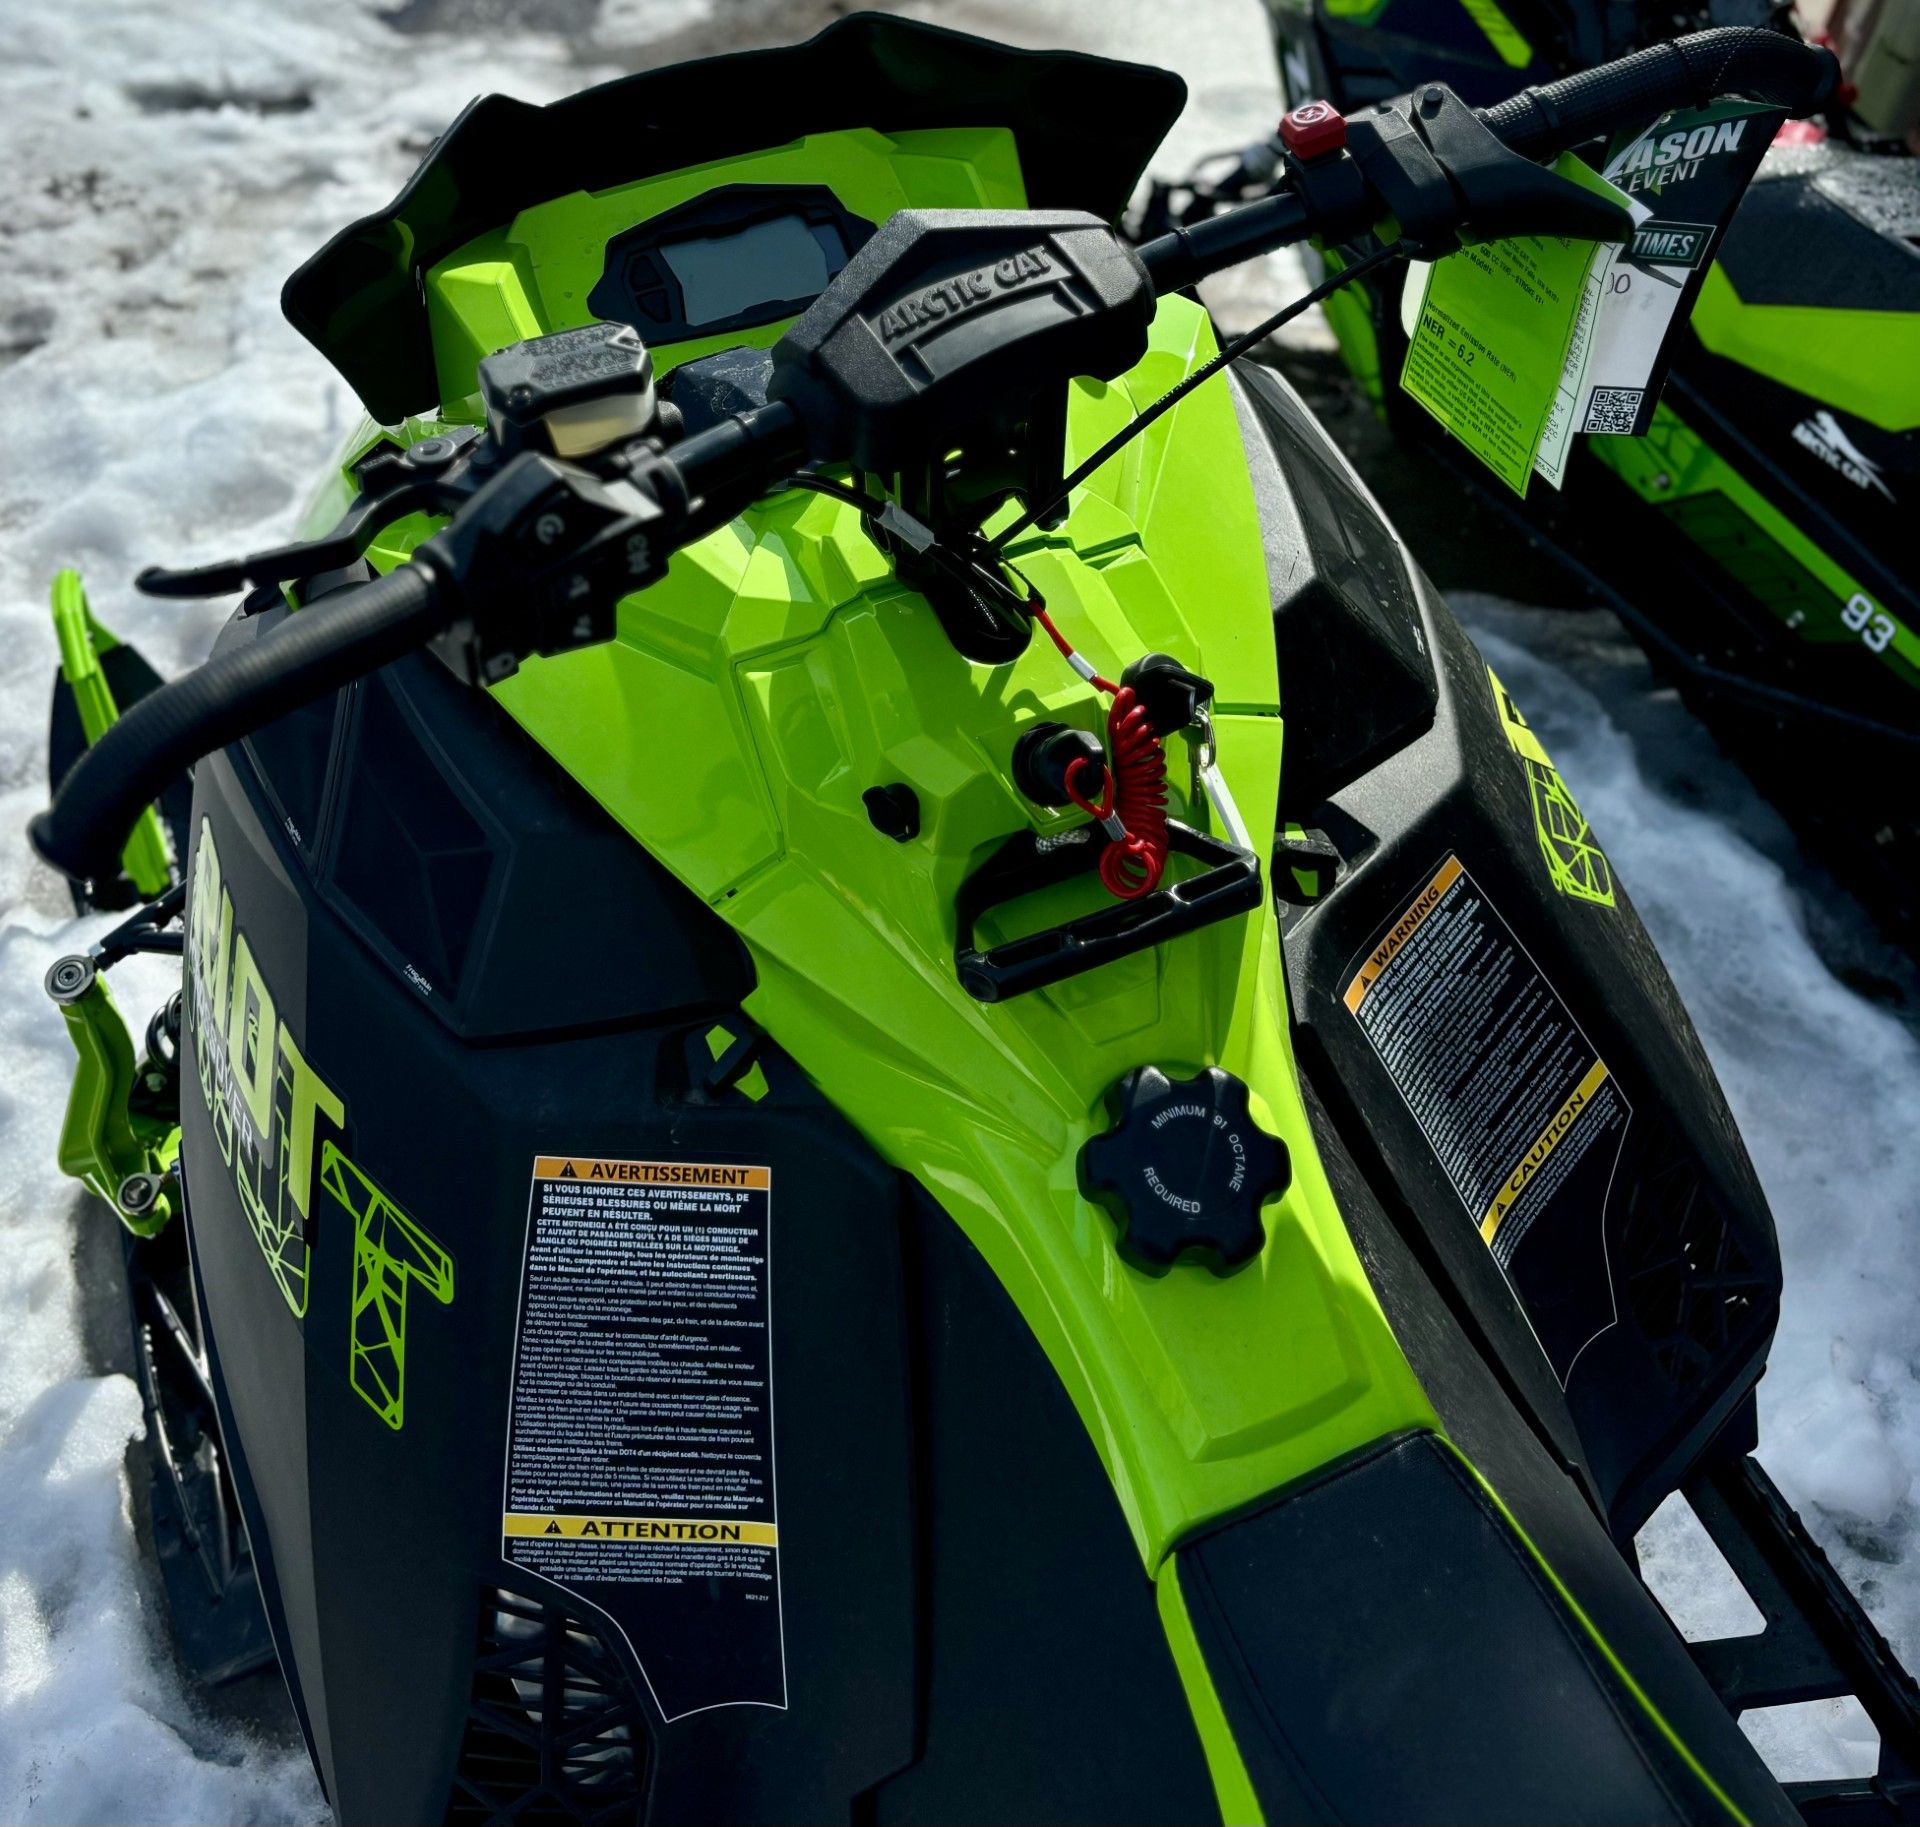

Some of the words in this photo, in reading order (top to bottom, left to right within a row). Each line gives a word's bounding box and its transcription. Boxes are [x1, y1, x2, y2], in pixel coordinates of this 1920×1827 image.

[1612, 119, 1748, 176] ASON
[1628, 158, 1704, 193] EVENT
[1631, 231, 1695, 257] TIMES
[880, 273, 992, 343] ARCTIC
[994, 245, 1052, 289] CAT
[1423, 314, 1445, 339] NER
[1457, 344, 1475, 367] 6.2
[1460, 327, 1486, 353] Emission
[1486, 348, 1501, 367] Rate
[1840, 592, 1897, 653] 93
[1372, 886, 1440, 967] WARNING
[1150, 1104, 1206, 1130] MINIMUM
[1213, 1114, 1228, 1130] 91
[1228, 1134, 1246, 1193] OCTANE
[1510, 1094, 1586, 1195] CAUTION
[590, 1163, 749, 1185] AVERTISSEMENT
[1143, 1166, 1201, 1214] REQUIRED
[542, 1193, 593, 1205] SÉRIEUSES
[596, 1198, 650, 1208] BLESSURES
[653, 1201, 666, 1209] OU
[670, 1199, 697, 1210] MÊME
[699, 1203, 711, 1211] LA
[714, 1204, 741, 1213] MORT
[543, 1184, 552, 1192] SI
[554, 1184, 580, 1193] VOUS
[582, 1185, 624, 1196] IGNOREZ
[627, 1188, 645, 1197] CES
[647, 1189, 733, 1202] AVERTISSEMENTS,
[736, 1193, 749, 1201] DE
[536, 1218, 560, 1226] CETTE
[562, 1220, 606, 1228] MOTONEIGE
[615, 1220, 628, 1229] ÉTÉ
[630, 1223, 657, 1232] CONÇU
[659, 1224, 680, 1232] POUR
[706, 1227, 758, 1235] CONDUCTEUR
[542, 1207, 585, 1216] PEUVENT
[587, 1209, 600, 1217] EN
[602, 1207, 652, 1220] RÉSULTER.
[536, 1236, 565, 1244] SANGLE
[579, 1237, 617, 1247] POIGNÉES
[619, 1239, 663, 1249] INSTALLÉES
[694, 1244, 740, 1253] MOTONEIGE.
[590, 1230, 633, 1238] PASSAGERS
[581, 1521, 740, 1540] ATTENTION
